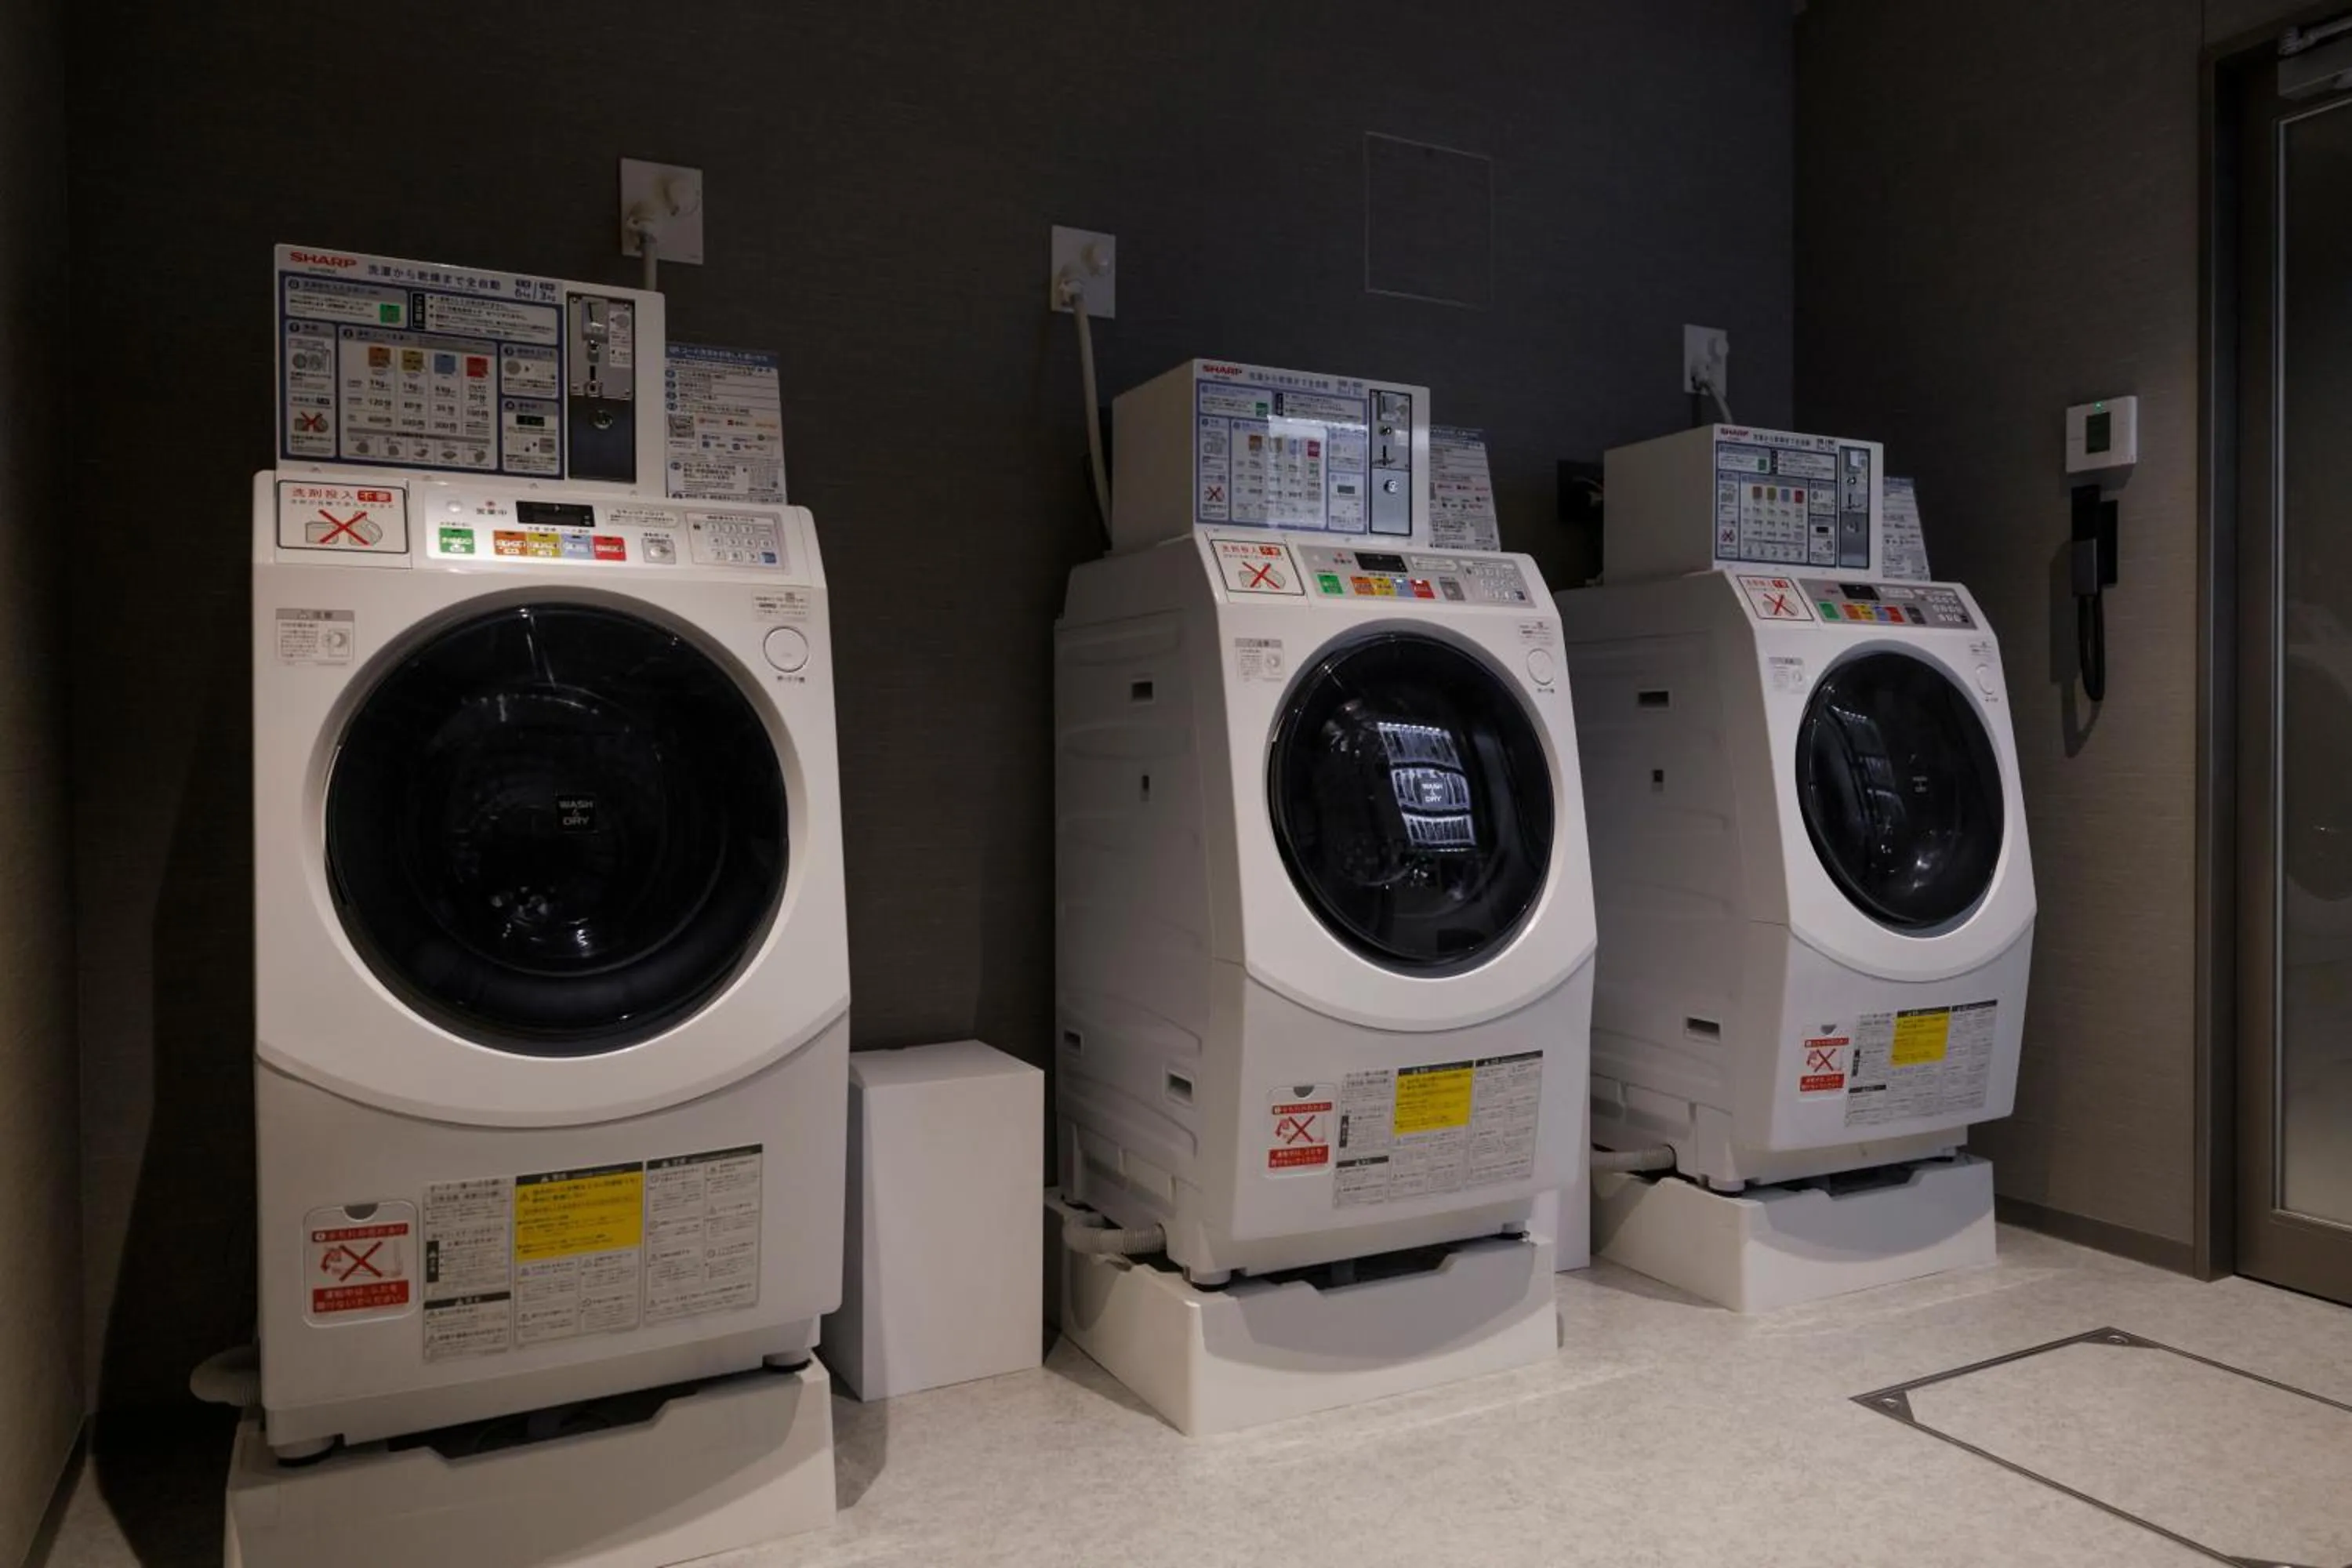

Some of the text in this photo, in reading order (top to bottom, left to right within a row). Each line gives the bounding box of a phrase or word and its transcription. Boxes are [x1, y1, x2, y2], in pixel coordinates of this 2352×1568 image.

[289, 251, 358, 268] SHARP
[368, 263, 501, 290] 洗濯から乾燥まで全自動
[1203, 365, 1243, 376] SHARP
[292, 487, 353, 499] 洗剤投入
[558, 800, 594, 809] WASH
[562, 815, 590, 826] DRY
